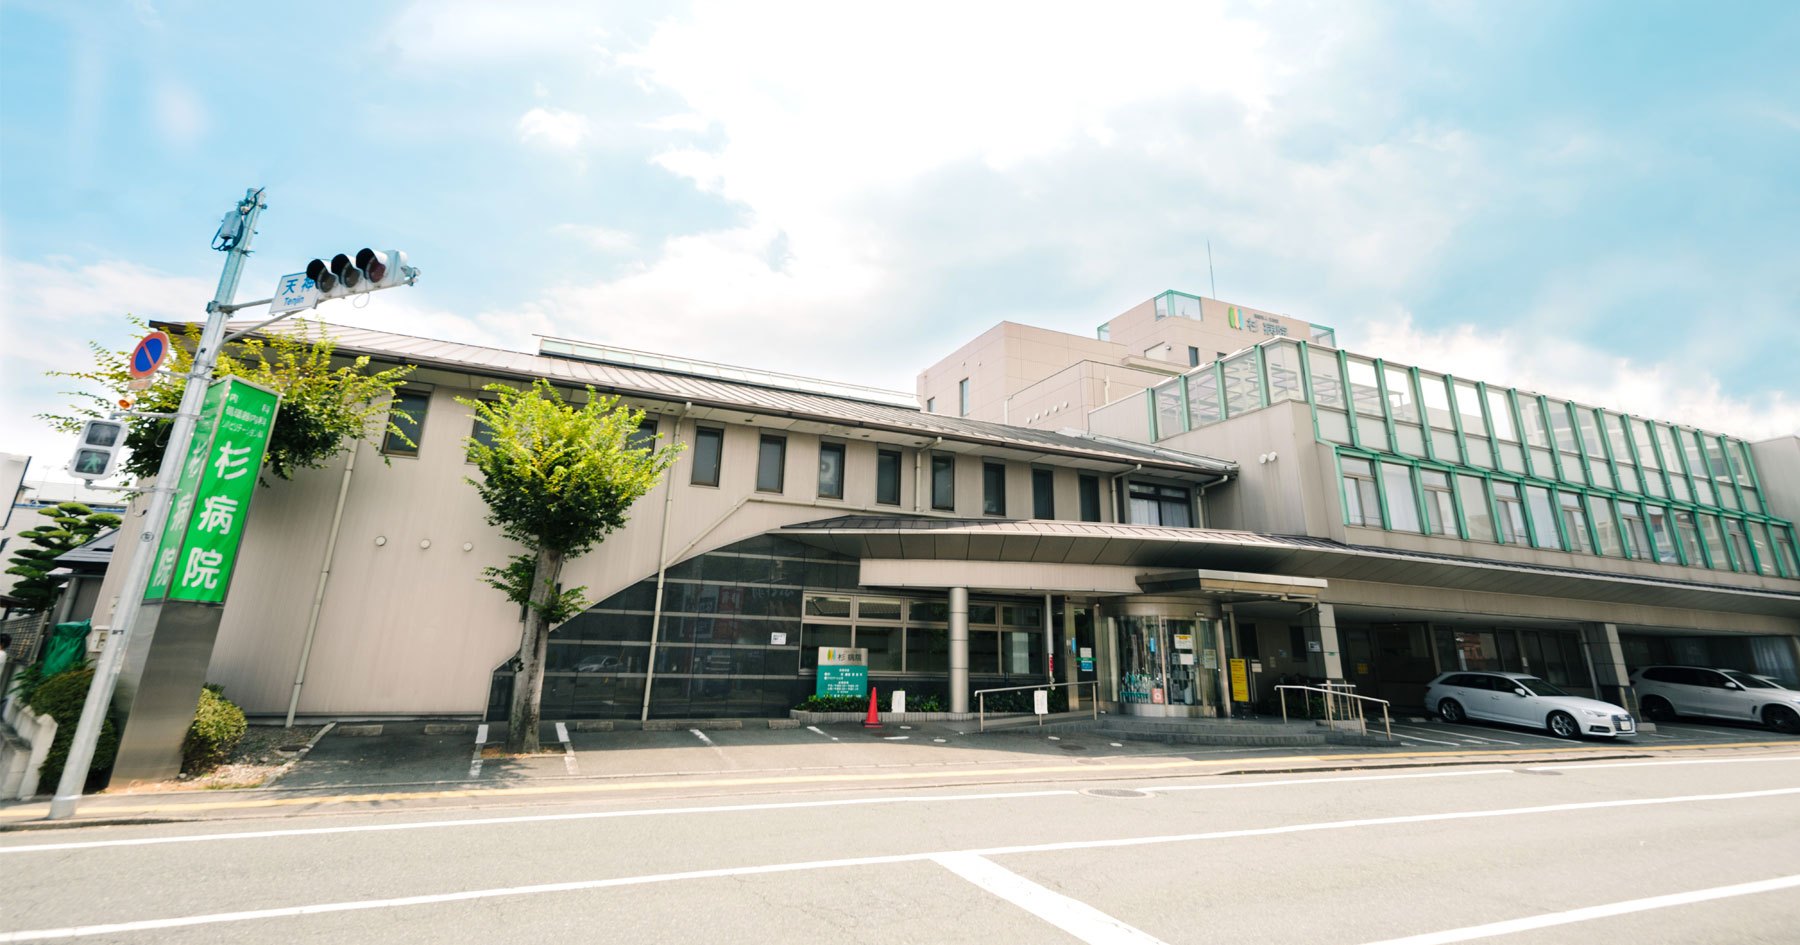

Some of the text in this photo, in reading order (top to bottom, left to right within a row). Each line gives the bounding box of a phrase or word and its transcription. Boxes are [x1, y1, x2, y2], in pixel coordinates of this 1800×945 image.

[282, 278, 315, 295] 天神
[284, 296, 304, 306] Tenjin
[182, 441, 251, 589] 杉病院
